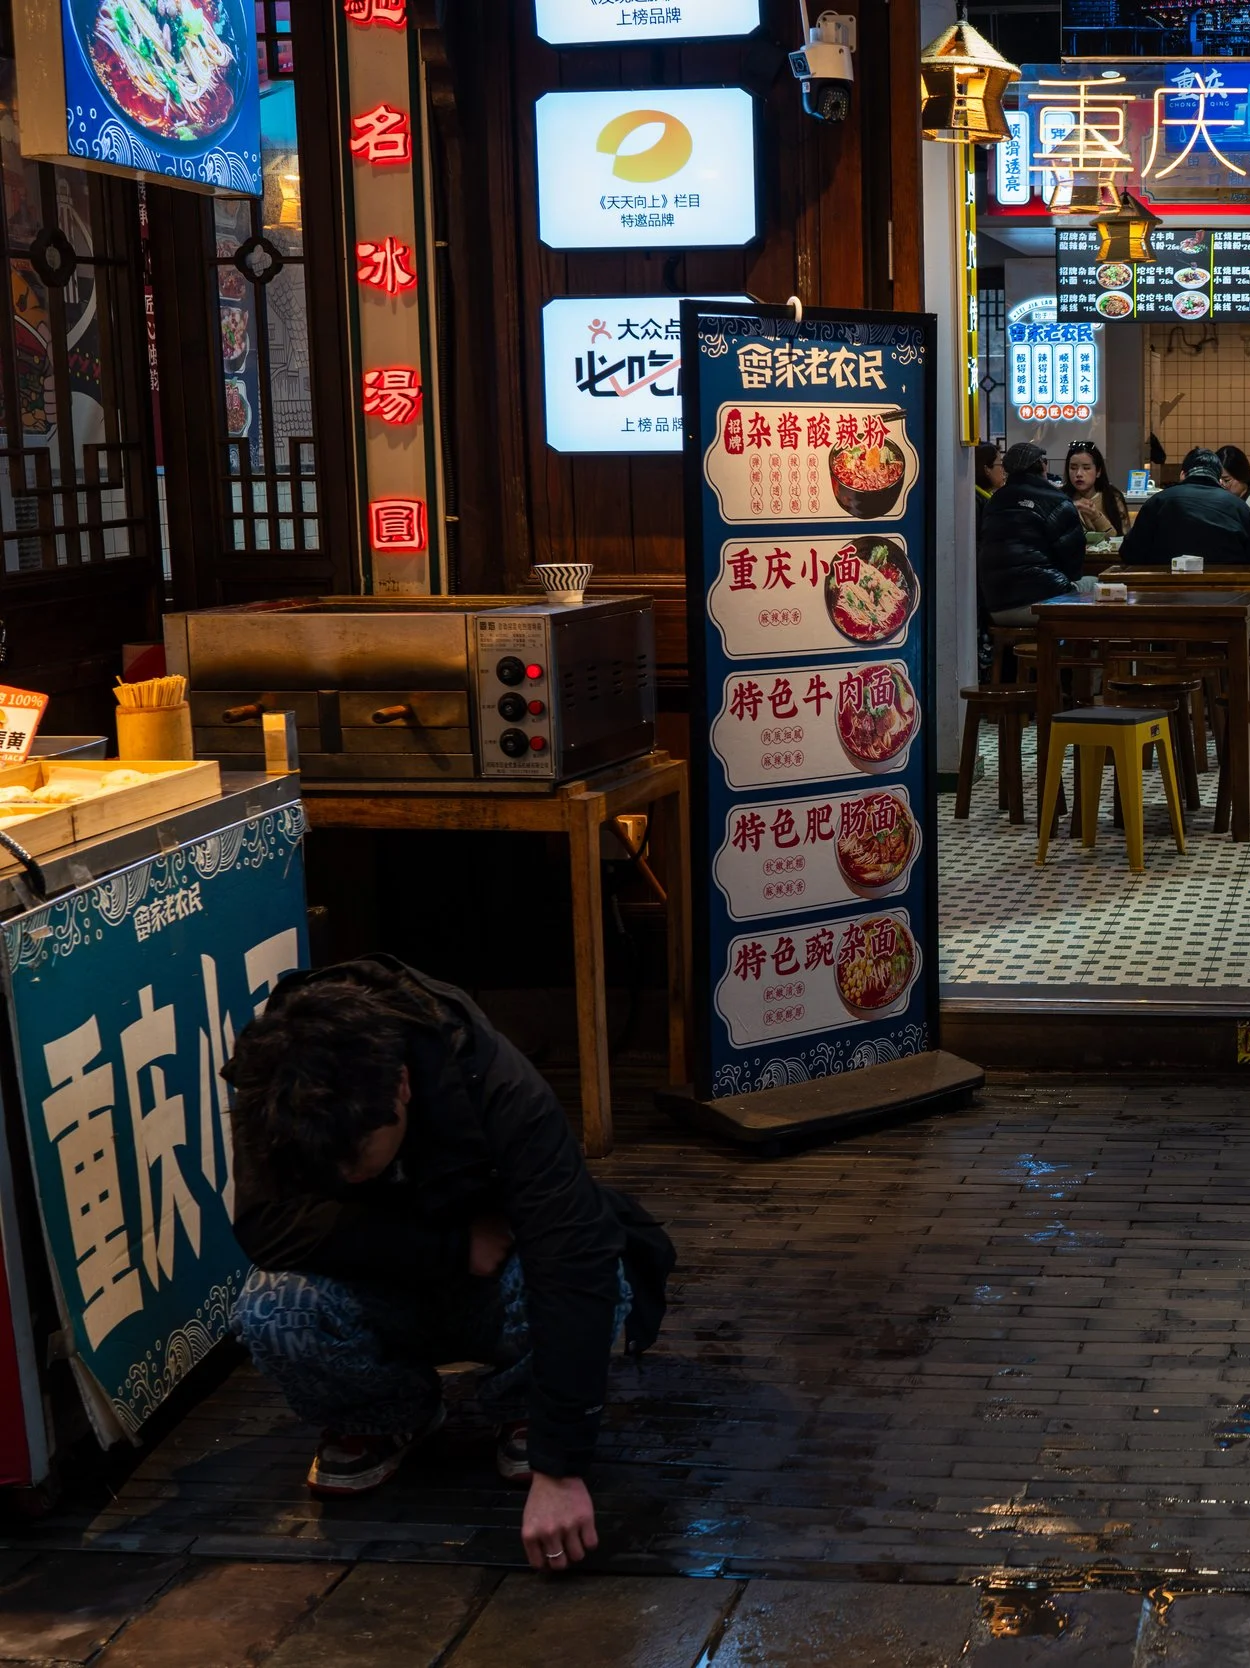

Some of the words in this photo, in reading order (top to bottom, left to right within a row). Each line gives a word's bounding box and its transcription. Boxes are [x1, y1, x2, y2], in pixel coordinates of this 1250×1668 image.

[616, 8, 682, 26] 上榜品牌
[599, 194, 701, 211] 《天天向上》栏目
[620, 213, 675, 228] 特邀品牌
[1059, 276, 1078, 284] 小面
[1137, 276, 1155, 284] 小面
[1213, 276, 1232, 284] 小面
[618, 318, 681, 341] 大众点
[576, 350, 683, 397] 必吃
[727, 419, 742, 451] 招牌
[746, 411, 891, 450] 杂酱酸辣粉
[726, 545, 861, 591] 重庆小面
[8, 693, 43, 707] 100%
[729, 668, 896, 721] 特色牛肉面
[731, 794, 897, 852] 特色肥肠面
[732, 918, 897, 981] 特色豌杂面
